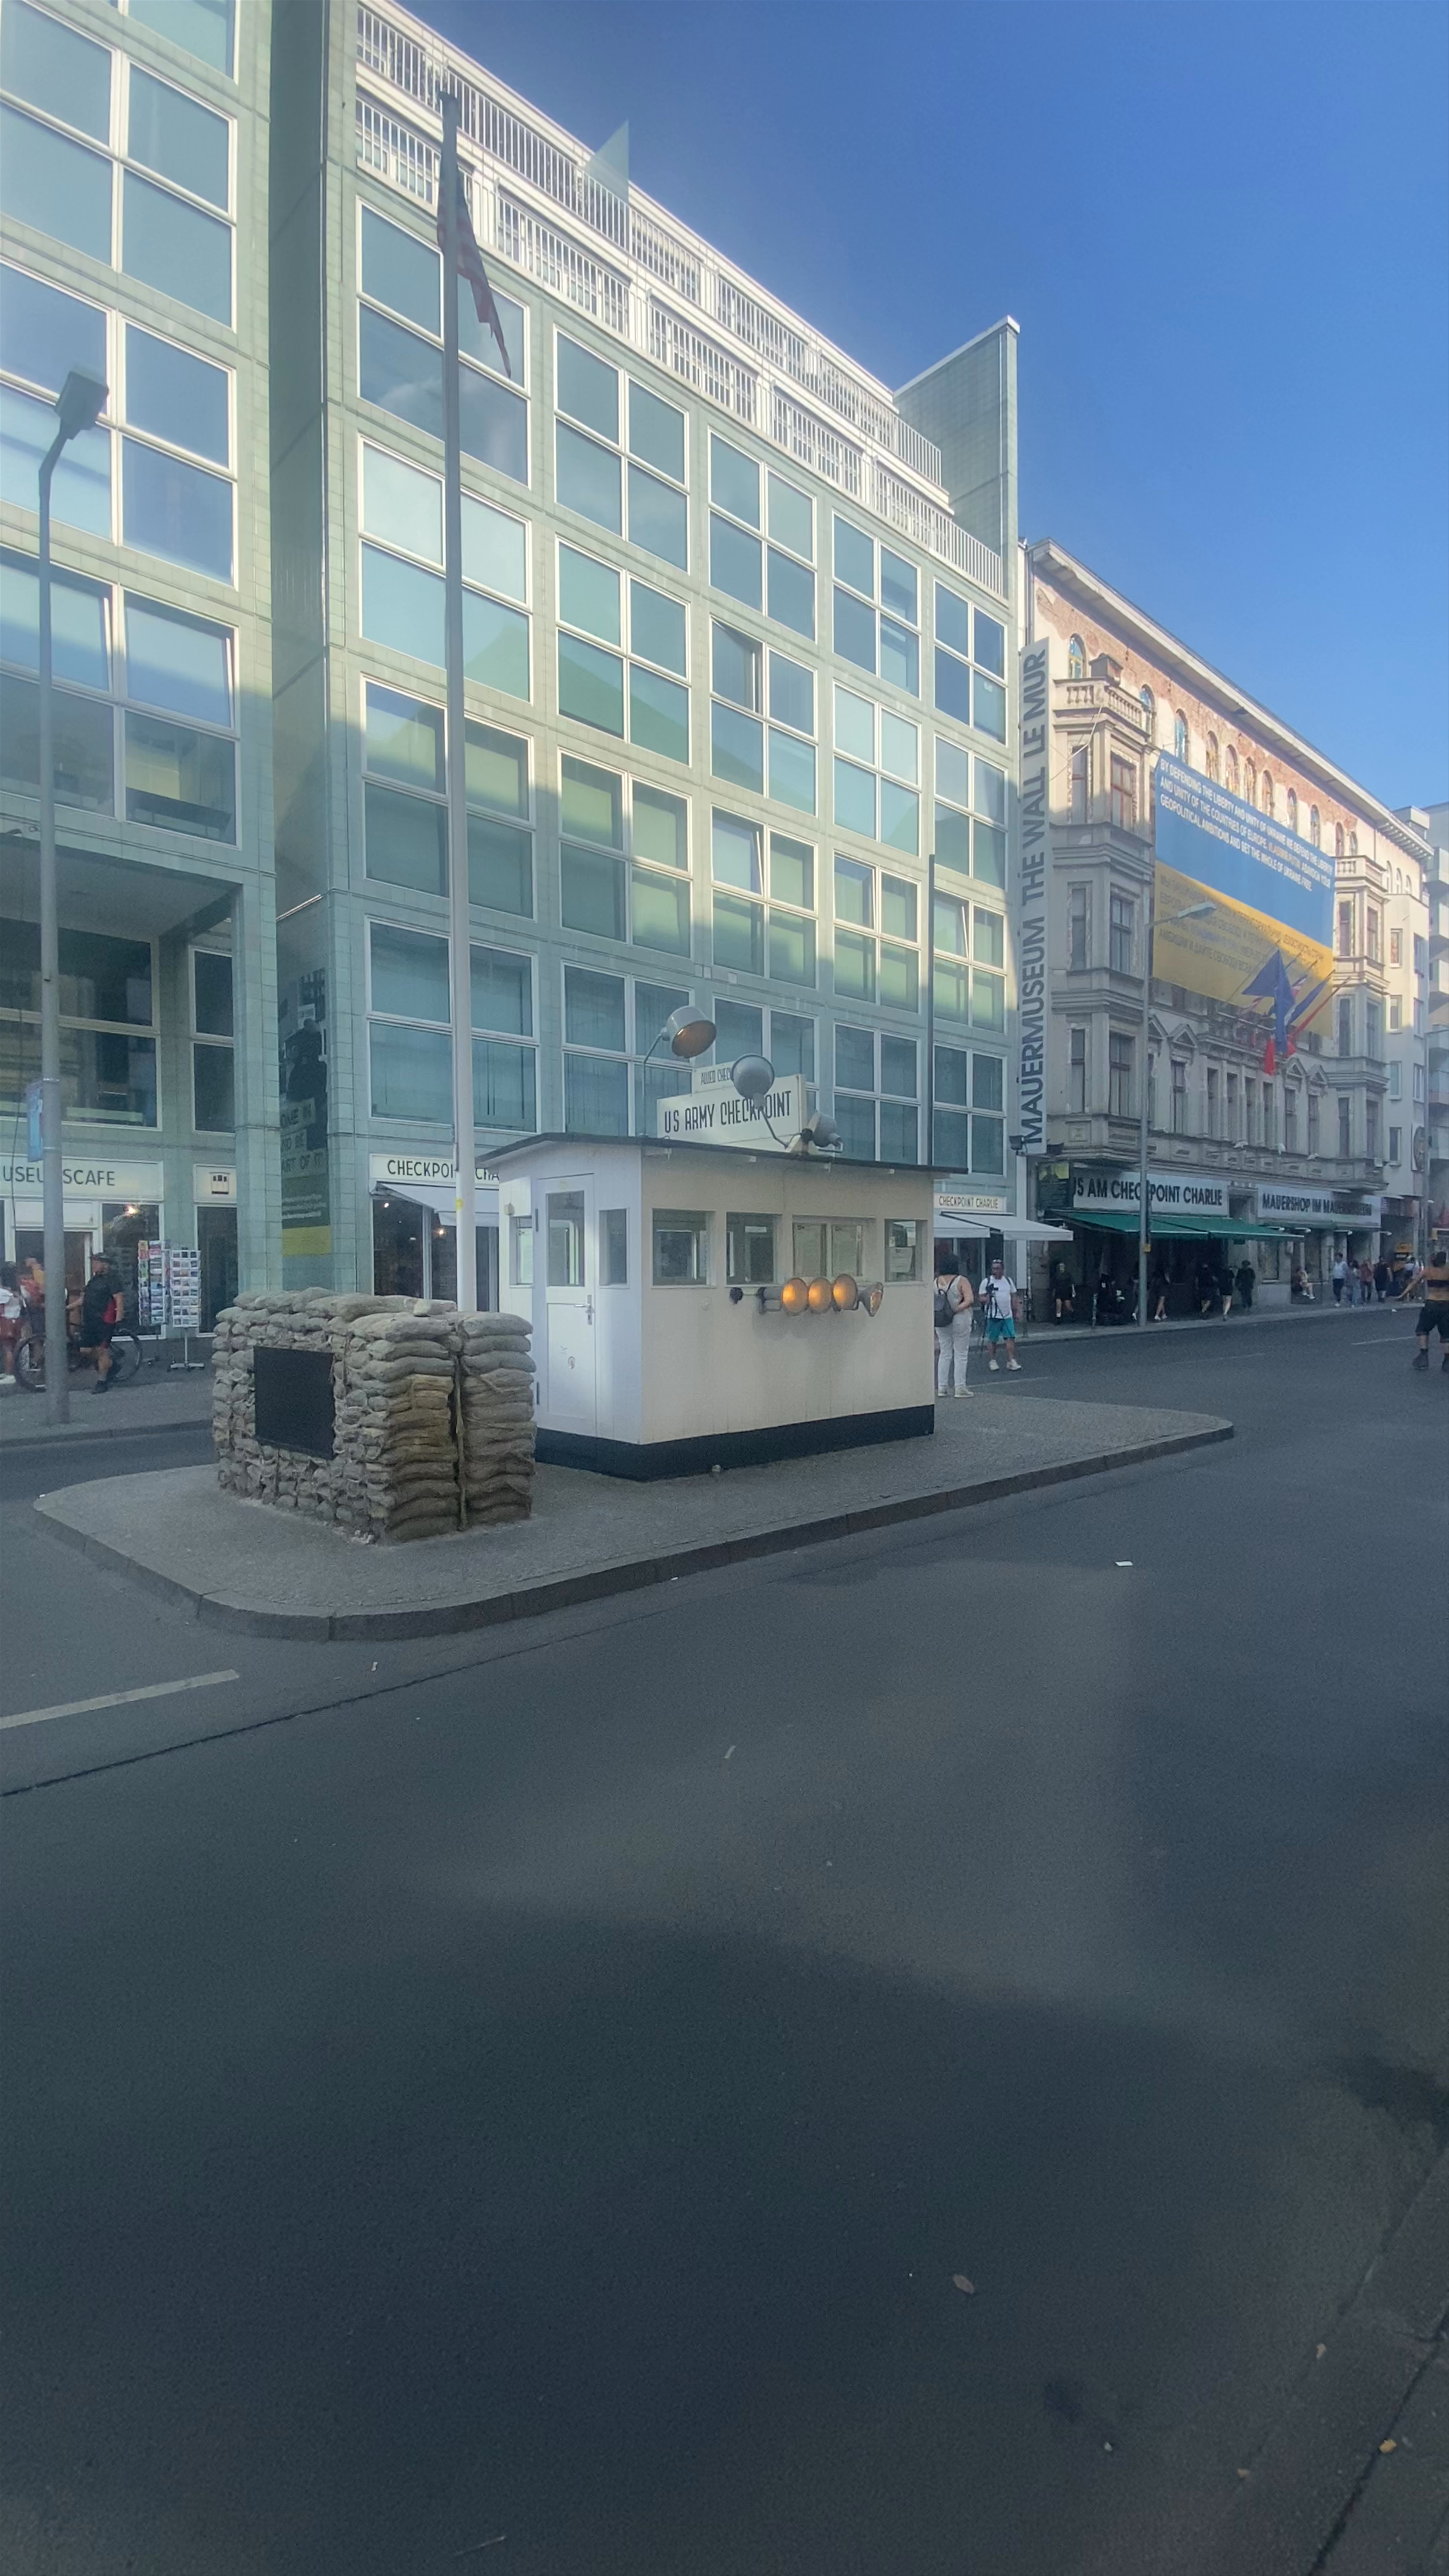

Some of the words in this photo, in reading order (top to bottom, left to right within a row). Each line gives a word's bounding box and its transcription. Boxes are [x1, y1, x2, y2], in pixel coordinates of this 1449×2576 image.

[1023, 649, 1045, 721] MUR
[1023, 724, 1045, 758] LE
[1022, 767, 1045, 850] WALL
[1021, 852, 1045, 906] THE
[1021, 916, 1045, 1144] MAUERMUSEUM
[280, 1107, 300, 1128] OME
[685, 1103, 715, 1131] ARMY
[720, 1090, 791, 1125] CHECKOINT
[3, 1166, 115, 1186] USEUSCAFE
[281, 1157, 296, 1172] ART
[387, 1160, 456, 1178] CHECKPOI
[939, 1196, 974, 1207] CHECKPOINT
[976, 1198, 998, 1209] CHARLIE
[1088, 1178, 1108, 1198] AM
[1111, 1180, 1180, 1203] CHECPOINT
[1183, 1186, 1223, 1206] CHARLIE
